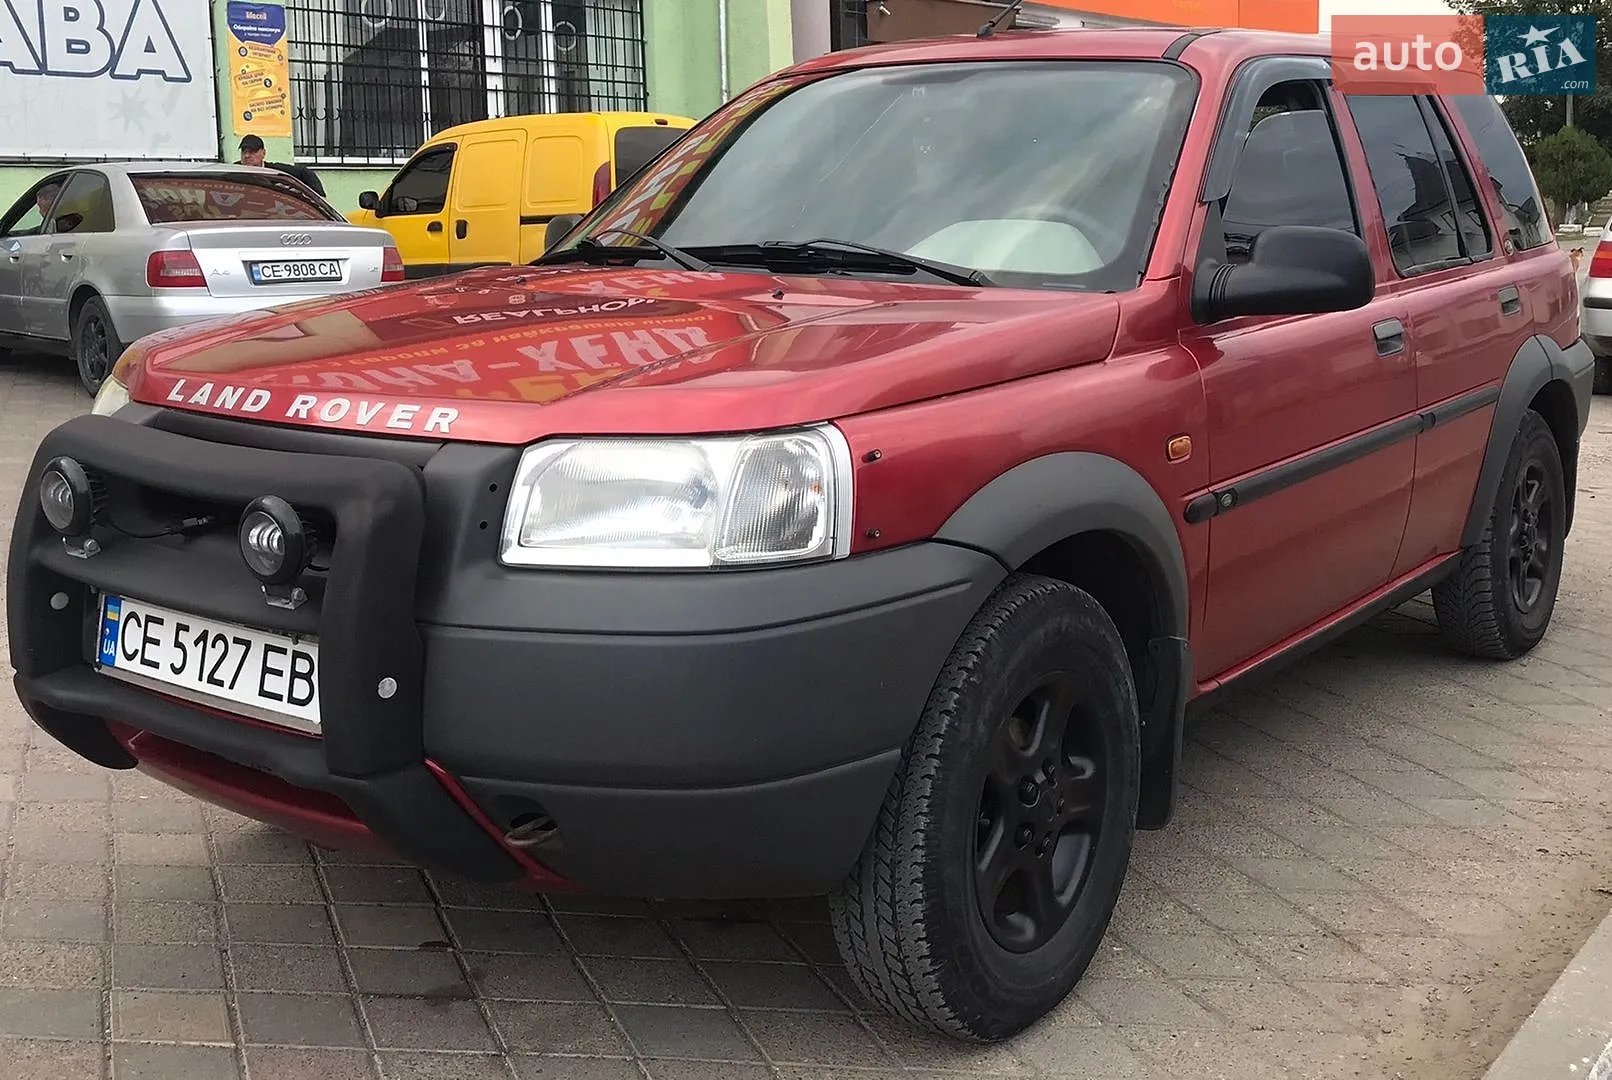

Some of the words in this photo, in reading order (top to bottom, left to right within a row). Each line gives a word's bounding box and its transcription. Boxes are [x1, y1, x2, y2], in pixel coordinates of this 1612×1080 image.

[284, 263, 317, 277] 9808
[318, 262, 338, 276] CA
[167, 378, 271, 413] LAND
[285, 394, 459, 433] ROVER
[103, 638, 116, 656] UA
[121, 611, 164, 669] CE
[170, 622, 252, 690] 5127
[258, 643, 316, 707] EB
